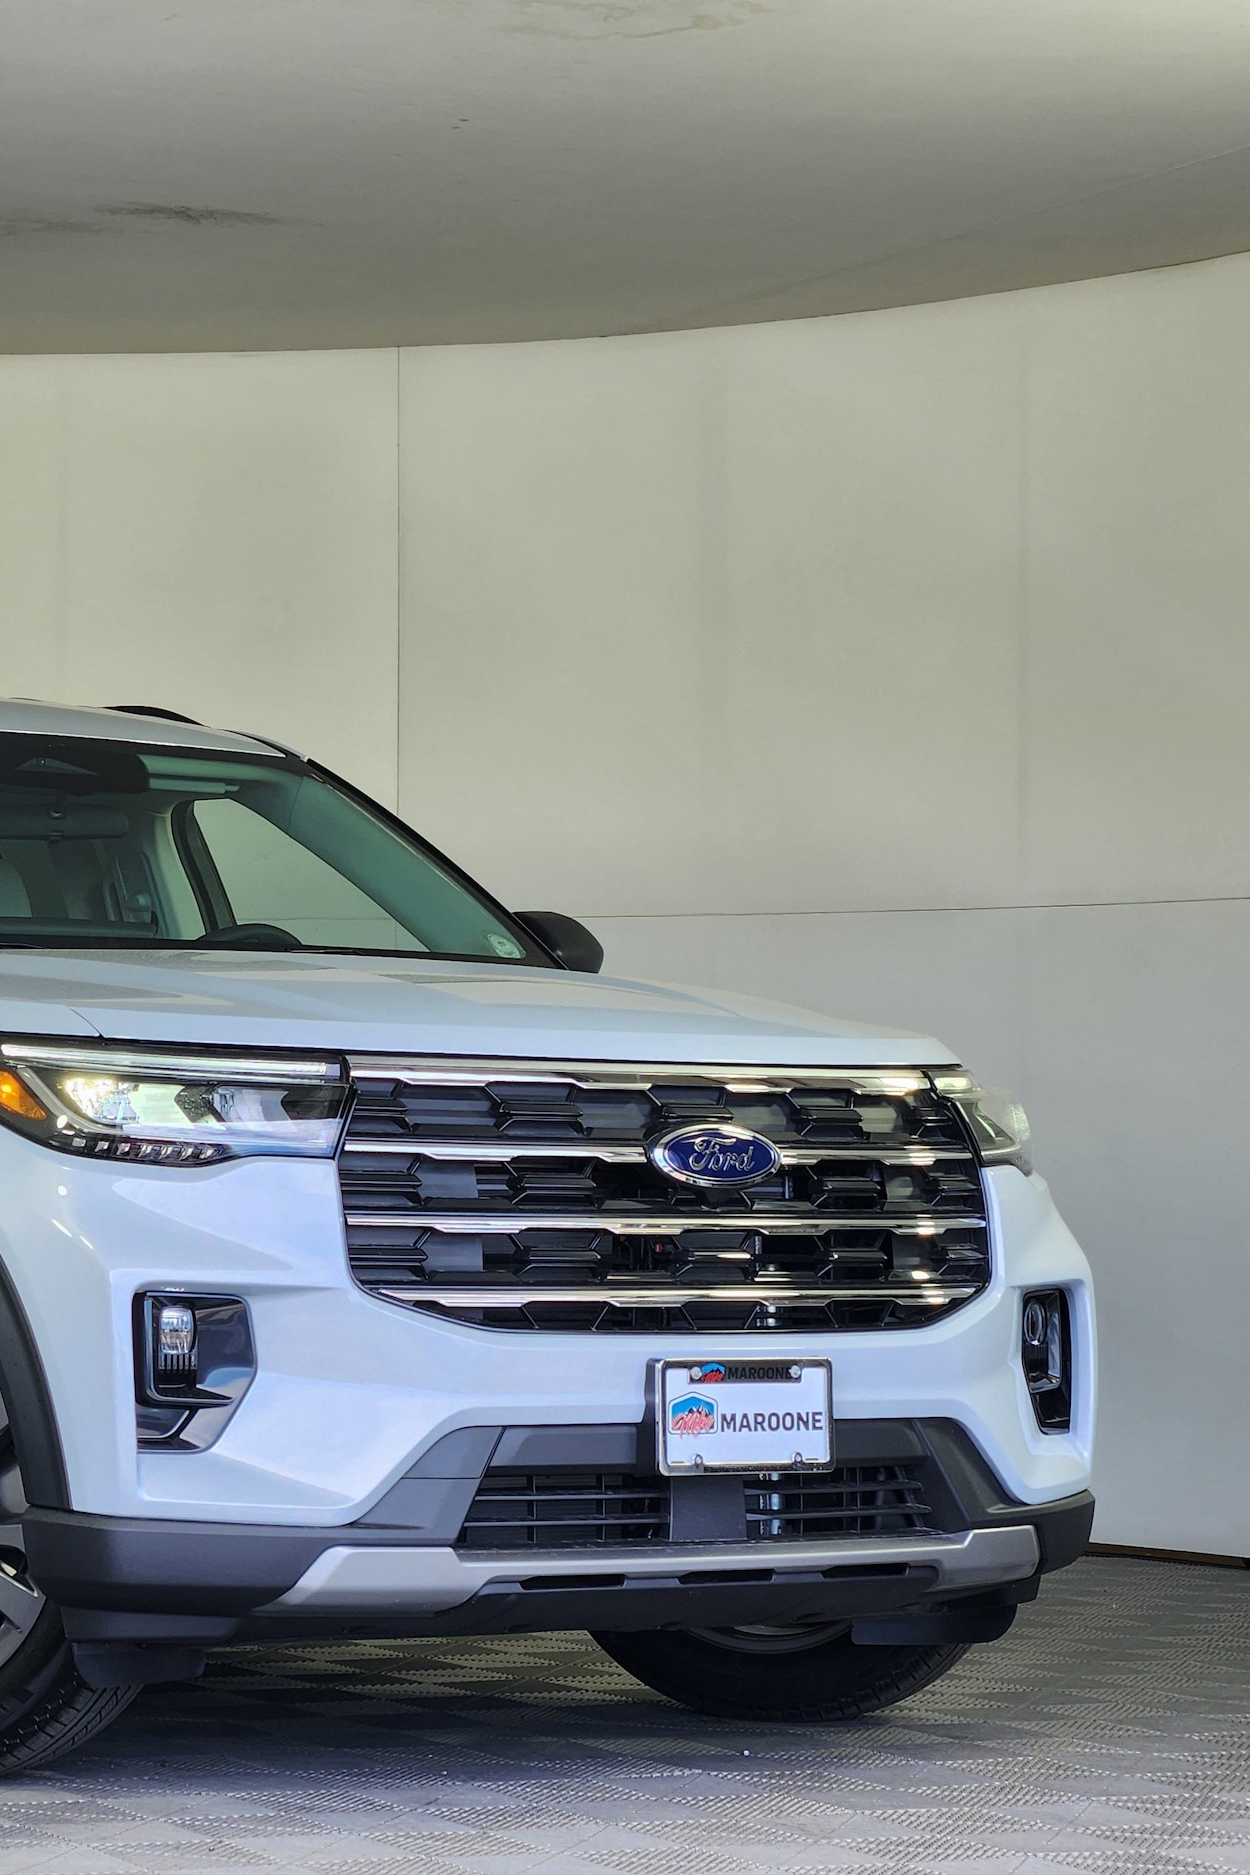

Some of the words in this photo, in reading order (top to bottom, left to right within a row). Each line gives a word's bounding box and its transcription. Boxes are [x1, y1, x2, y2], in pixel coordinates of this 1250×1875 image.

[682, 1136, 756, 1172] Ford
[671, 1410, 716, 1439] Mike
[720, 1411, 823, 1433] MAROONE
